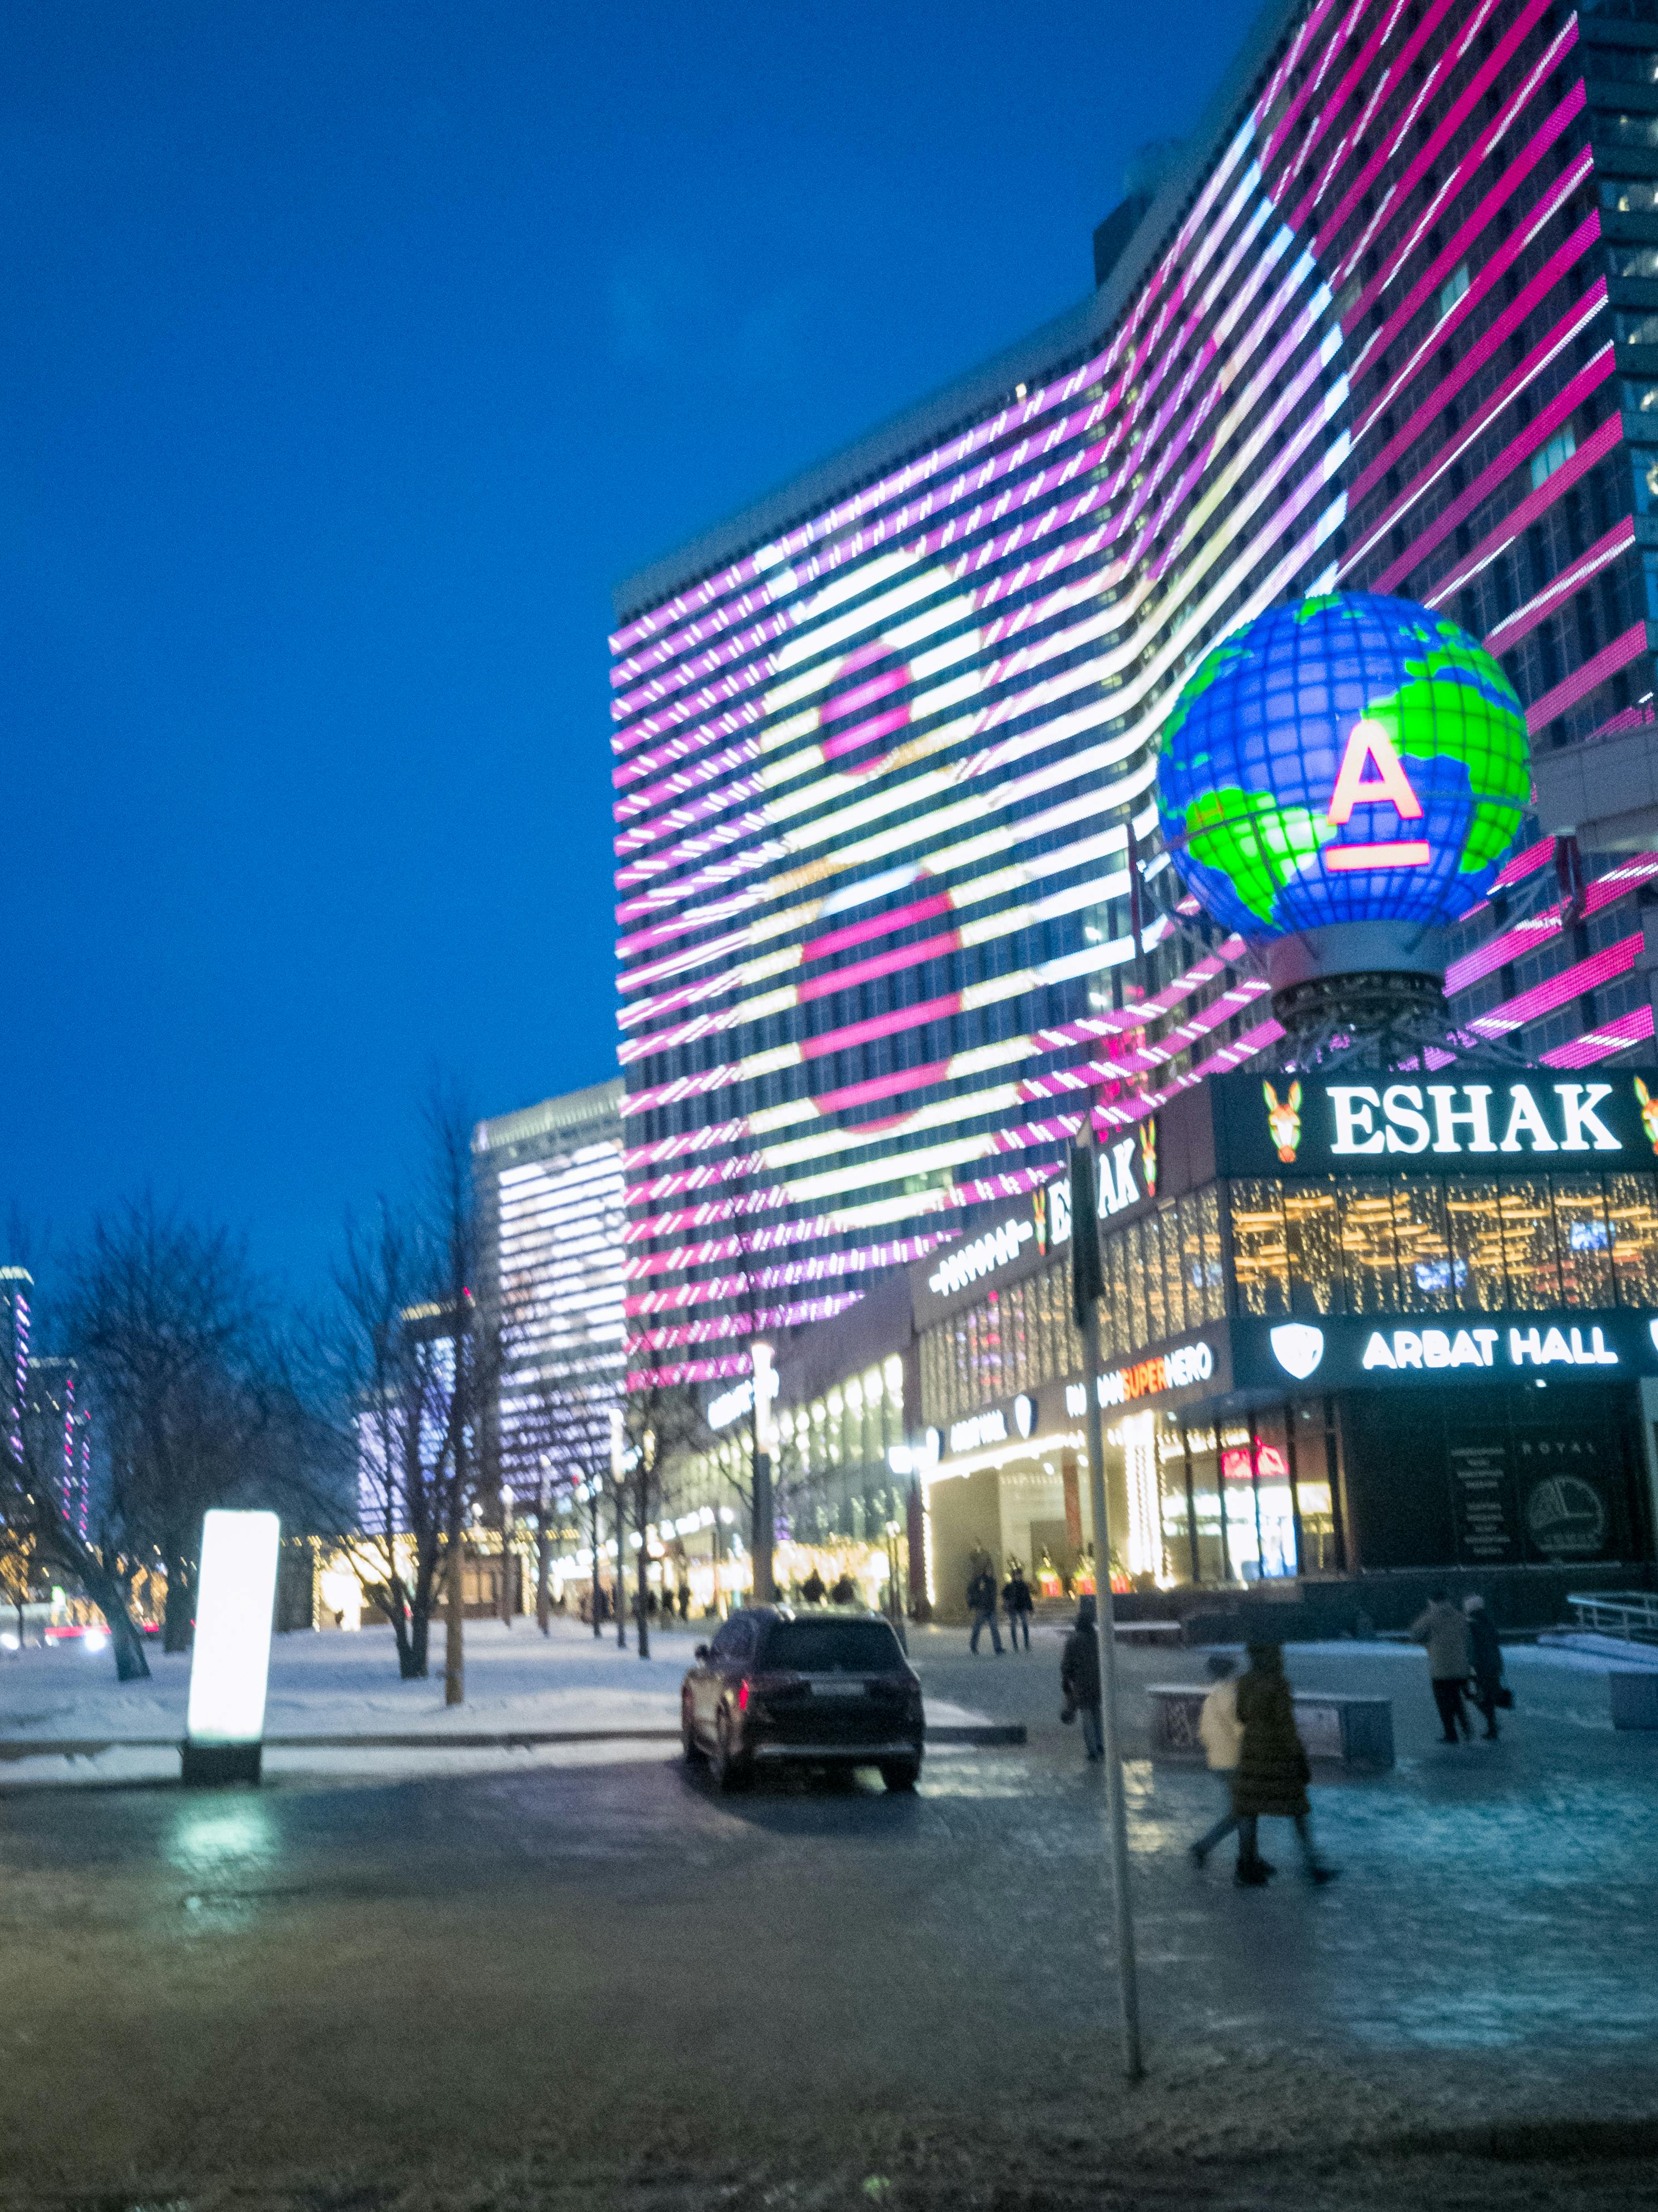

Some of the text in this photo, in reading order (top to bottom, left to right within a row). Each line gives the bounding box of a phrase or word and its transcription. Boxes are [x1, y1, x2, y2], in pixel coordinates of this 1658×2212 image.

[1327, 719, 1424, 825] A
[1326, 1084, 1622, 1154] ESHAK
[1048, 1137, 1141, 1246] EAK
[1362, 1326, 1619, 1369] ARBAT HALL
